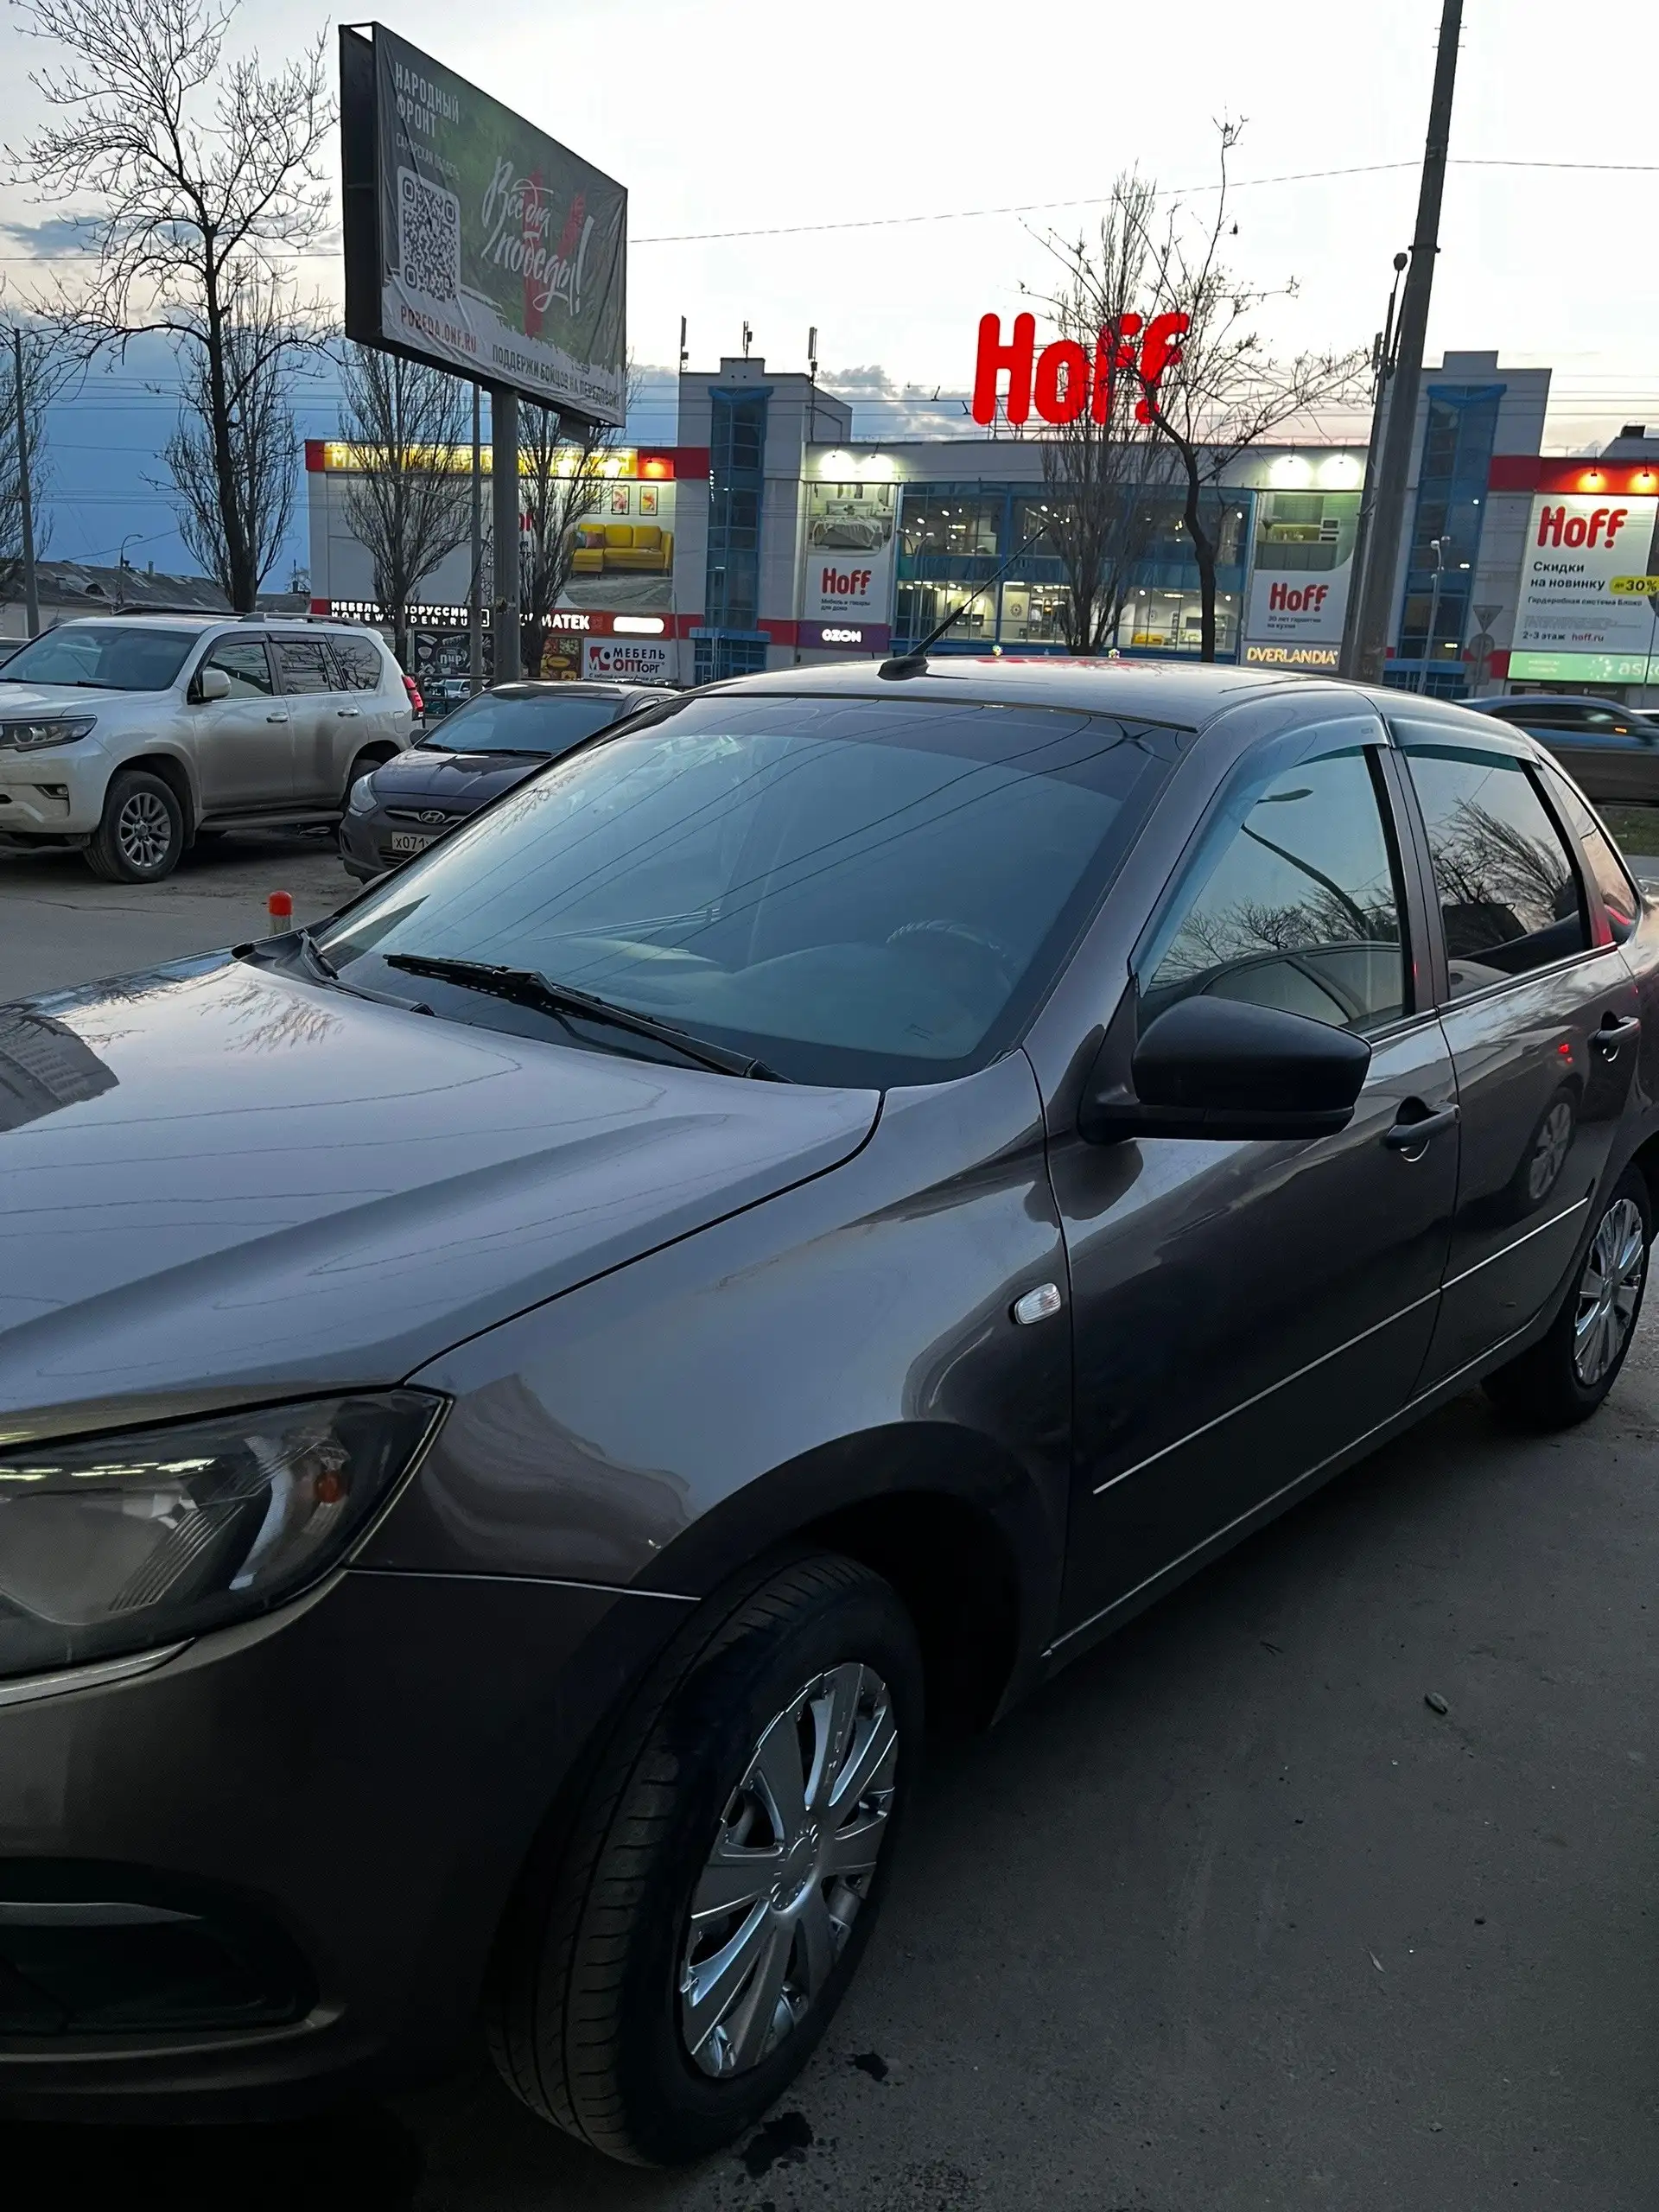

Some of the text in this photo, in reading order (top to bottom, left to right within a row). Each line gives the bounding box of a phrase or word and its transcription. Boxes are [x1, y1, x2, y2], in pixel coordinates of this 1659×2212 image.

[395, 60, 460, 124] НАРОДНЫЙ
[397, 93, 436, 138] ФРОНТ
[492, 344, 539, 378] ПОДДЕРЖИ
[1537, 505, 1628, 549] Hoff
[1533, 561, 1585, 575] Скидки
[822, 567, 872, 596] Hoff
[1530, 578, 1605, 591] на новинку
[1625, 580, 1657, 593] 30%
[1269, 582, 1330, 613] Hoff
[331, 601, 380, 613] МЕБЕЛЬ
[821, 628, 863, 643] OZON
[1541, 632, 1566, 641] этаж
[1571, 632, 1605, 642] hoff.ru
[613, 647, 665, 660] МЕБЕЛЬ
[1246, 645, 1337, 665] DVERLANDIA
